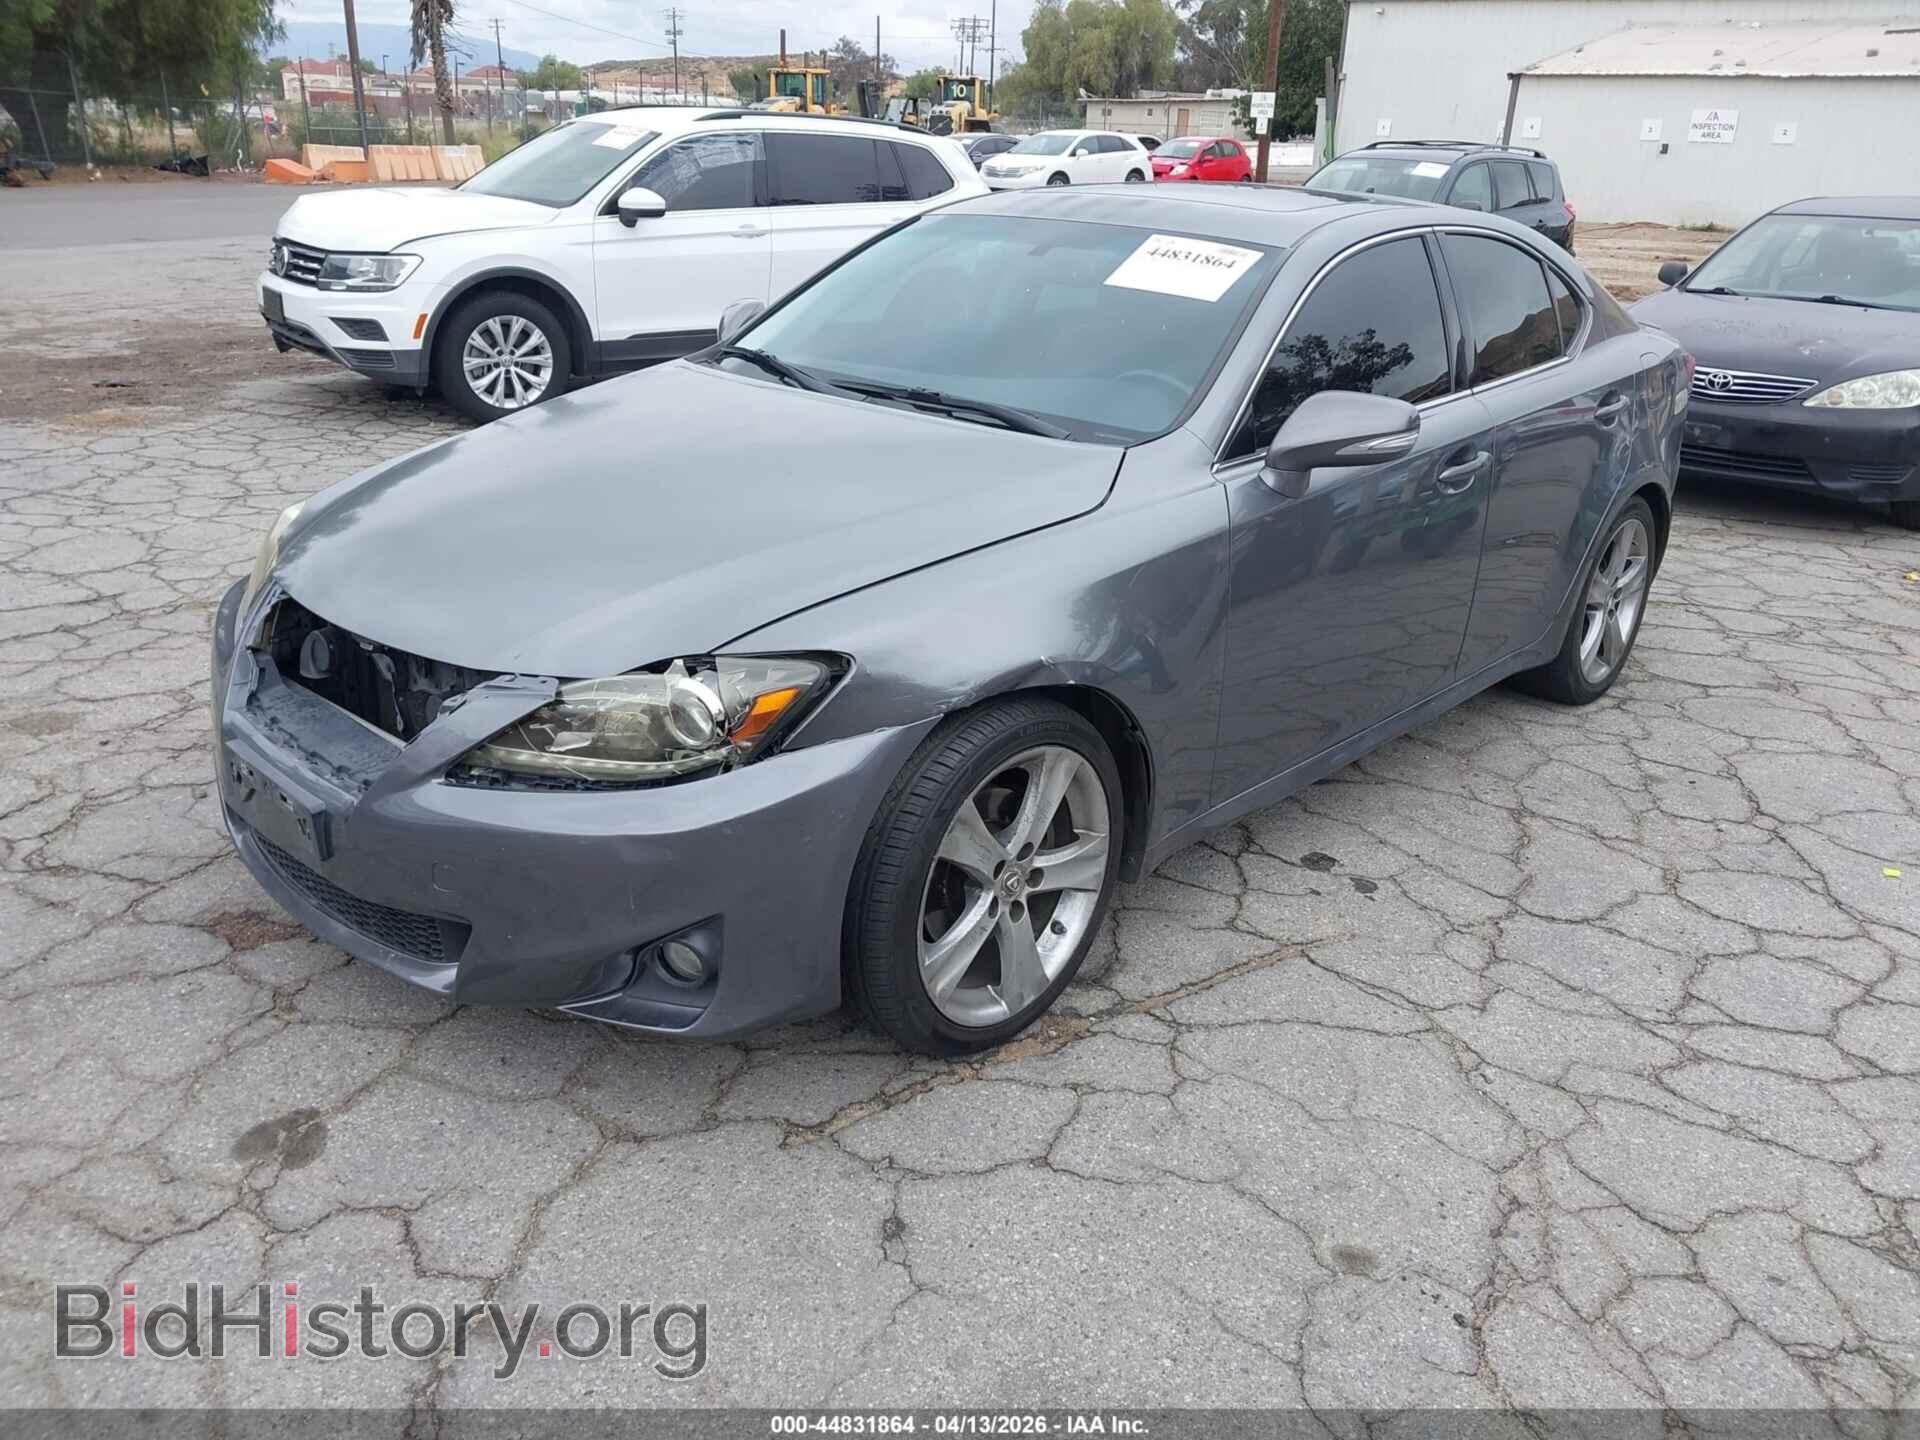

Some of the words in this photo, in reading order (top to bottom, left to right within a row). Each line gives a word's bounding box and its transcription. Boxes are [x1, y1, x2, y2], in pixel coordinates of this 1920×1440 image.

[951, 84, 966, 97] 10
[1691, 122, 1734, 131] INSPECTION
[1701, 131, 1721, 139] AREA
[1147, 247, 1238, 269] 44831864
